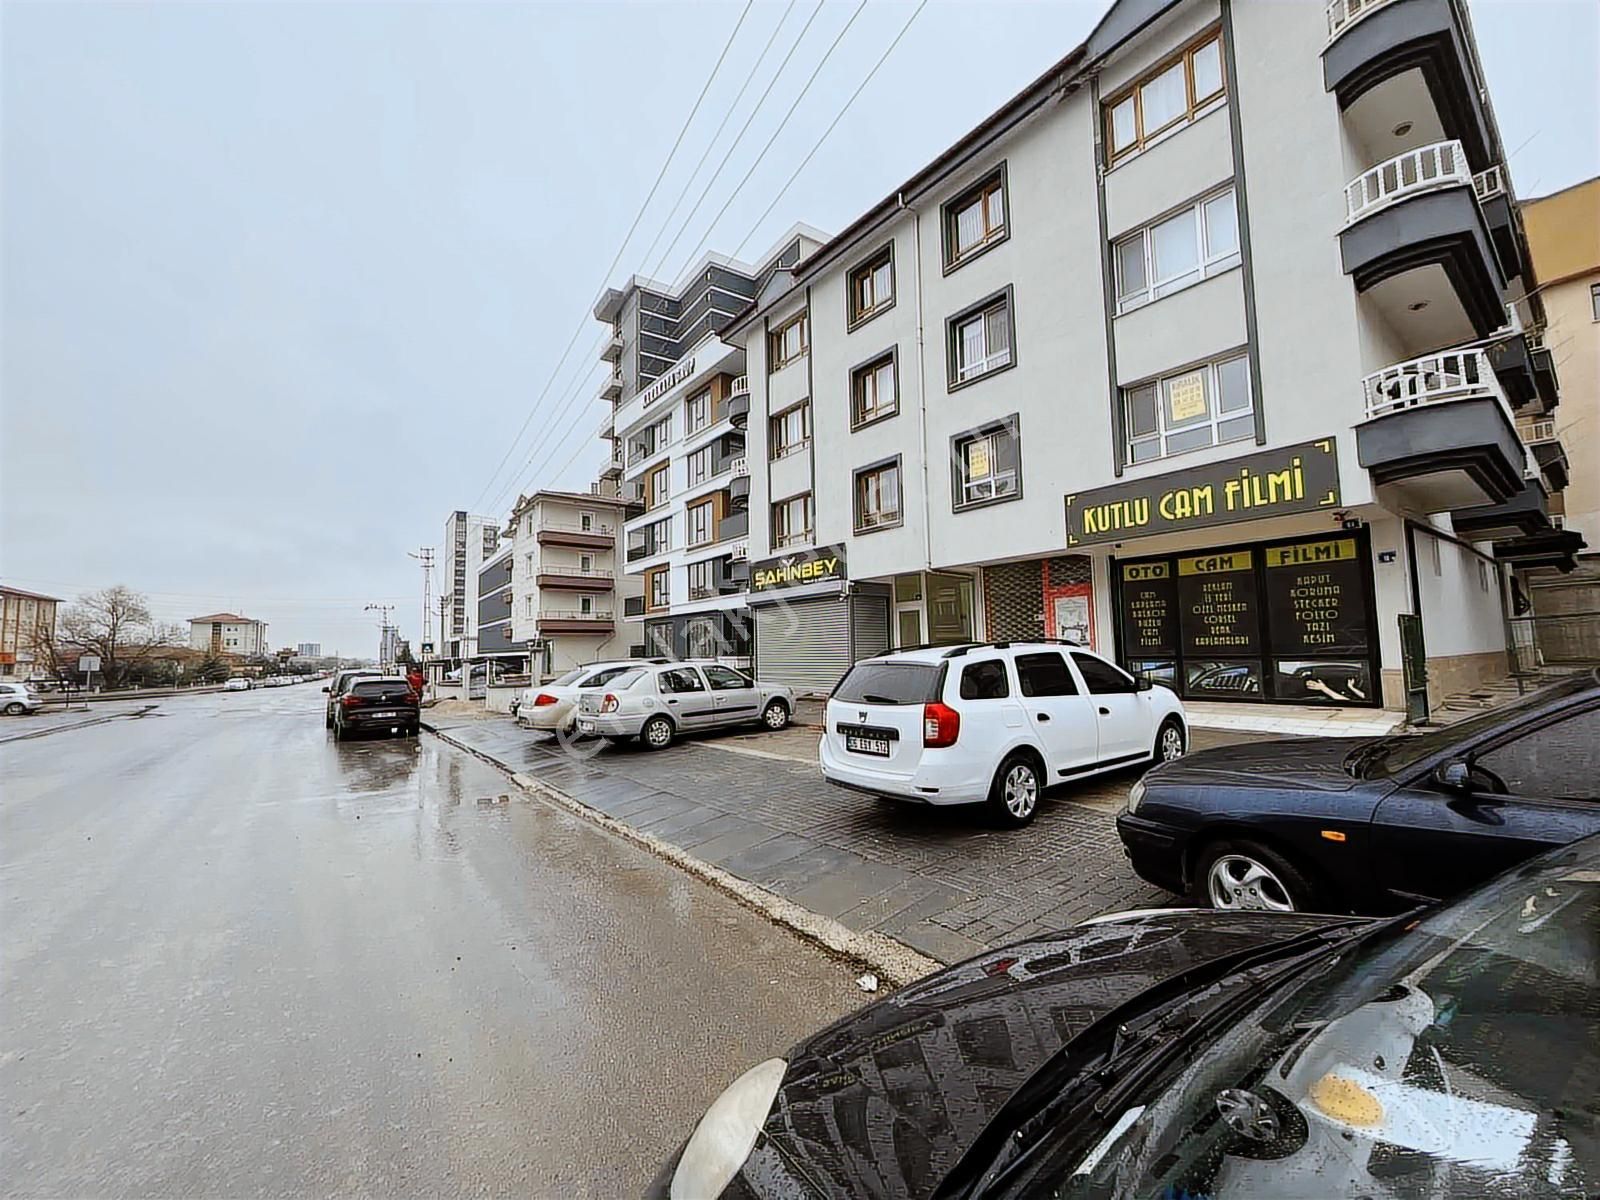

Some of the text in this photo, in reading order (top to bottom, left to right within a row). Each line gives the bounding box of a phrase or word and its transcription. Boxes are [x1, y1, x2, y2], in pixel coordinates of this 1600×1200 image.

[1083, 456, 1305, 535] KUTLU CAM FİLMİ
[1128, 541, 1340, 579] OTO CAM FİLMİ
